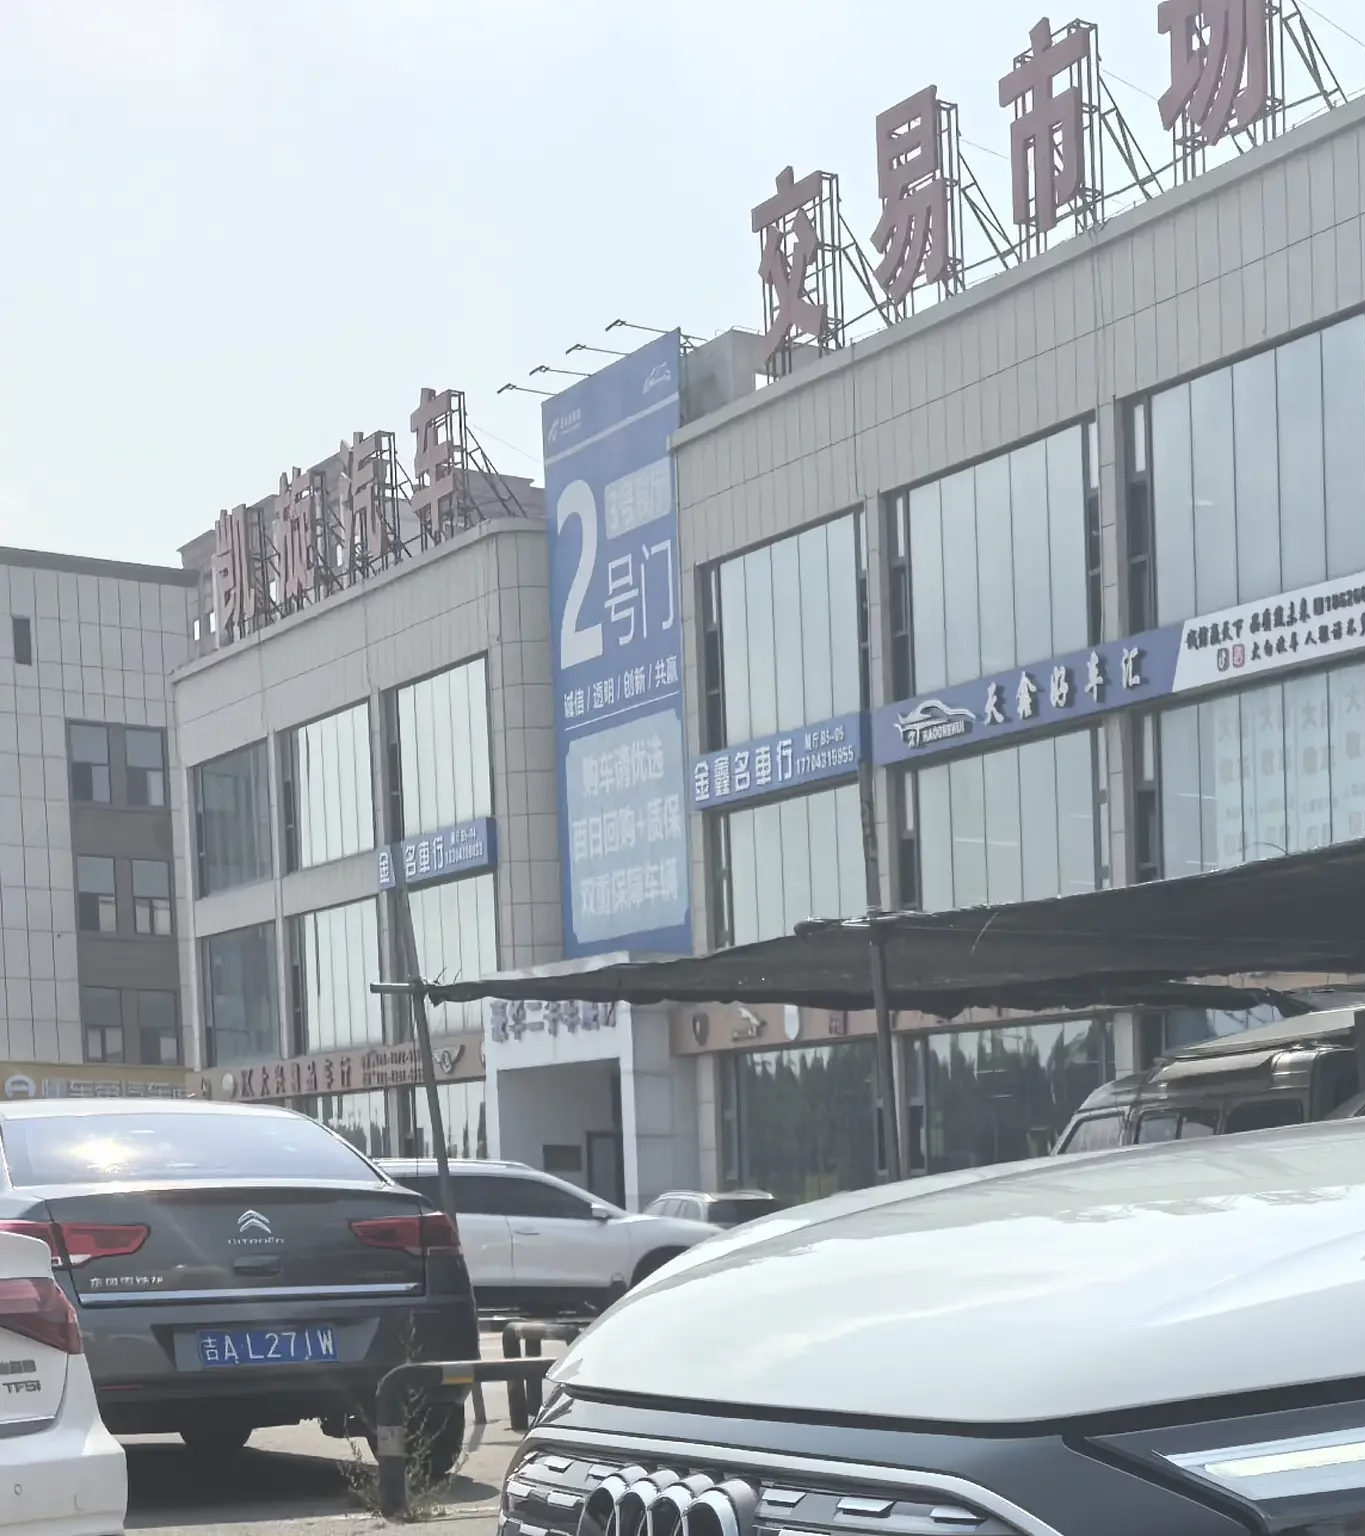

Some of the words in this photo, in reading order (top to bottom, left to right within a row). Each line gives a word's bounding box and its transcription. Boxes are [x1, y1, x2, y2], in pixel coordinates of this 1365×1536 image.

[752, 0, 1268, 366] 交易市场
[380, 835, 443, 883] 金名車行
